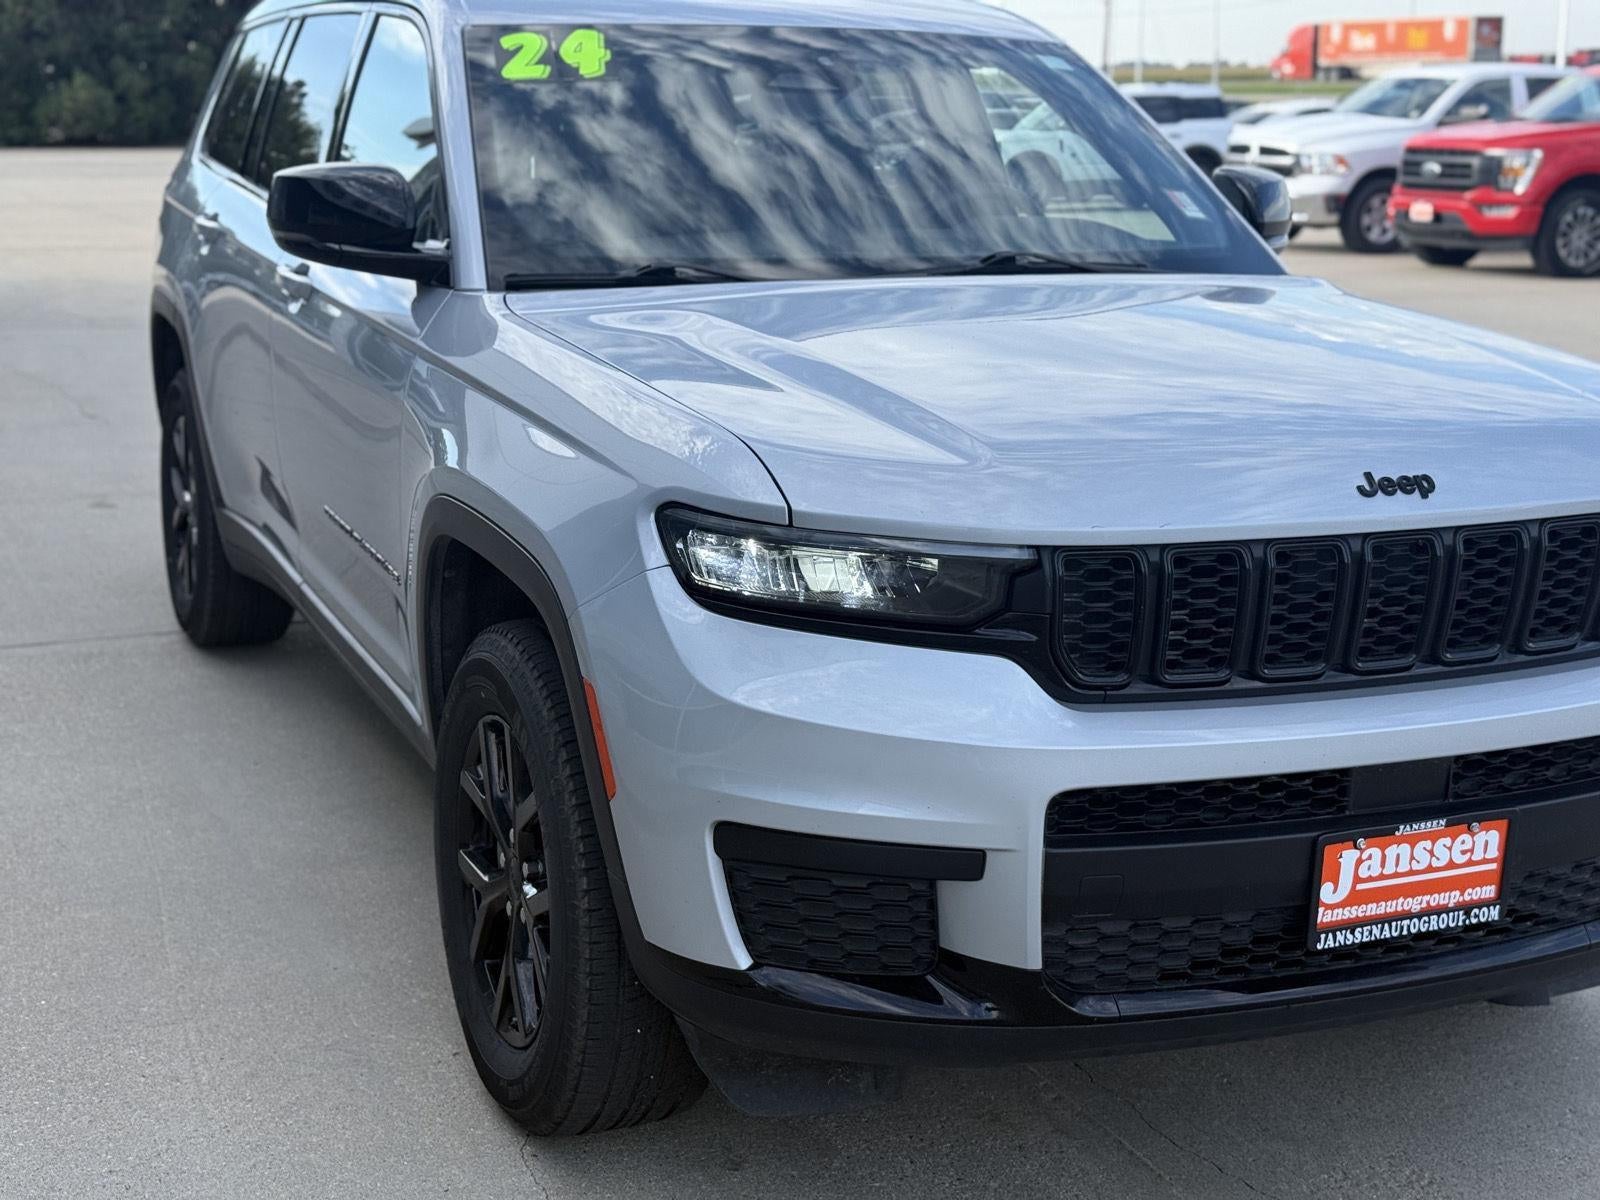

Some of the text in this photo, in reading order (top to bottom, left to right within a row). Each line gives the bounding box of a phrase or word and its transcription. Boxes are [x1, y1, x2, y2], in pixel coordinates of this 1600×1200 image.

[499, 29, 611, 80] 24
[1356, 471, 1435, 499] Jeep
[1394, 818, 1447, 836] JANSSEN
[1319, 829, 1499, 904] Janssen
